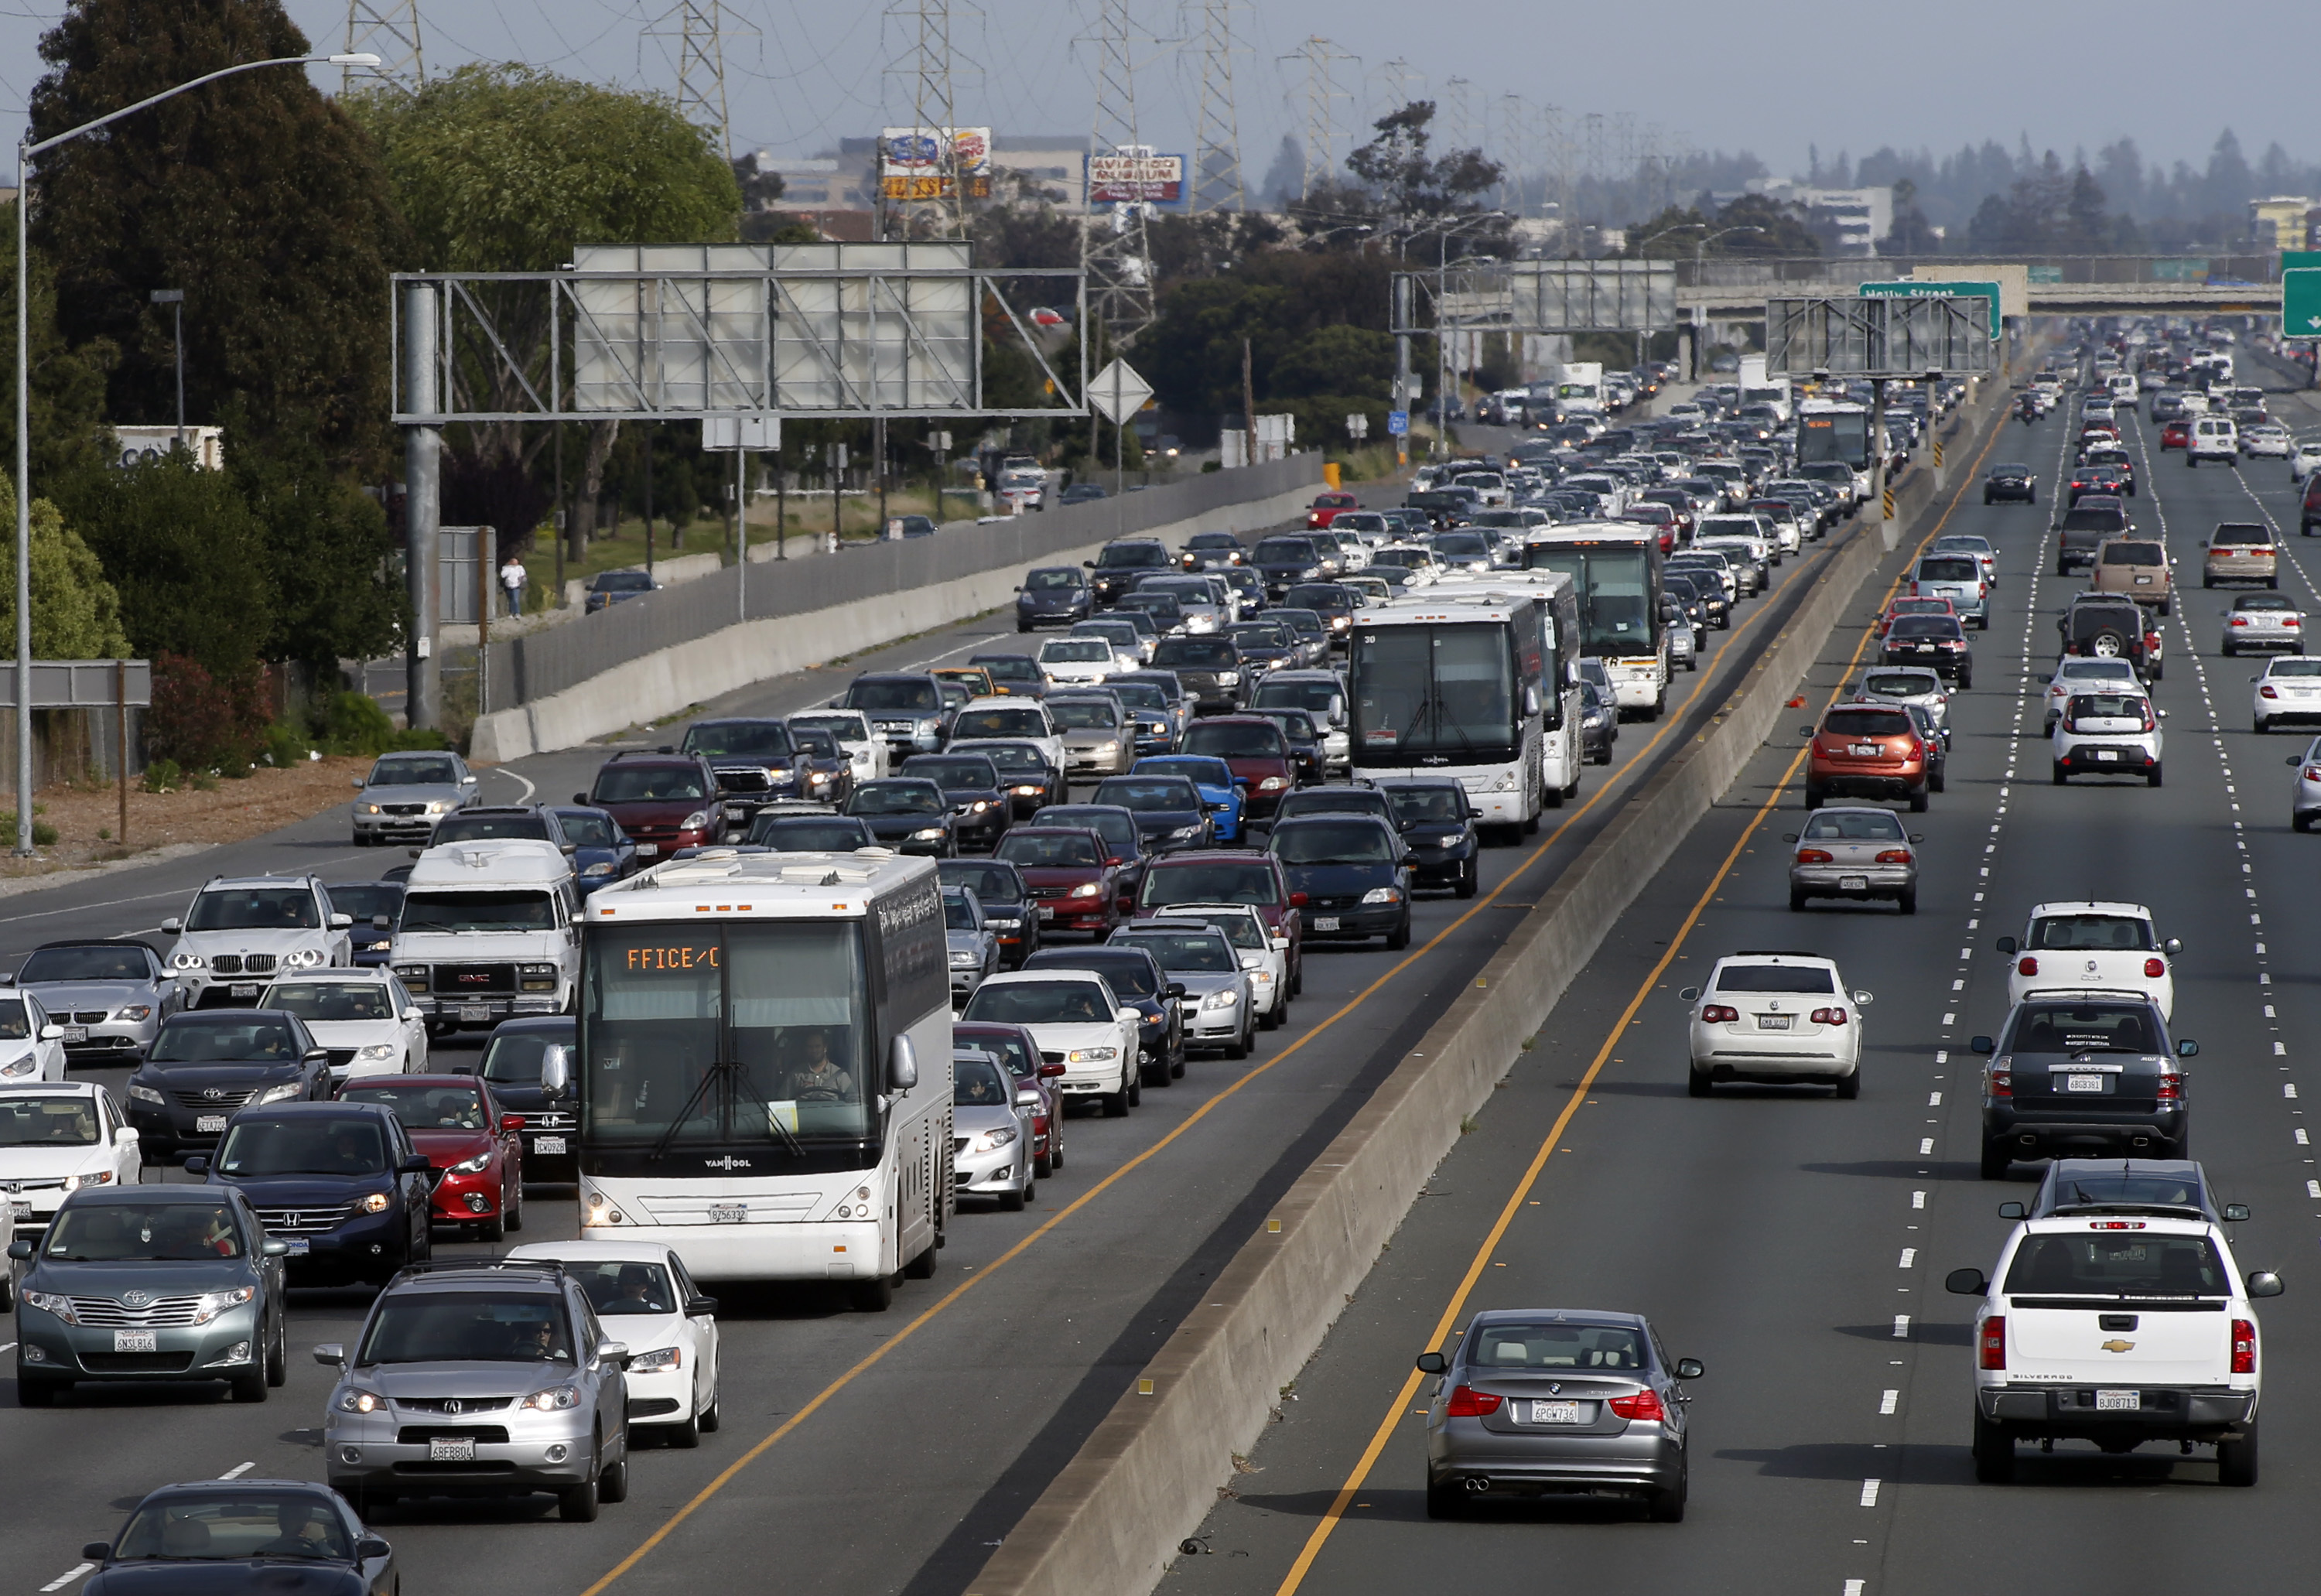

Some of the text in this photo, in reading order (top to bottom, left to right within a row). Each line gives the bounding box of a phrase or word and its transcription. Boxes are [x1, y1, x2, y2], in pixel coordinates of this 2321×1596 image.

[1365, 635, 1376, 644] 30
[117, 1338, 153, 1348] 6NSL816
[2099, 1397, 2138, 1409] 8J08713
[1535, 1408, 1574, 1420] 6PGW736
[433, 1446, 472, 1458] 6BFB804
